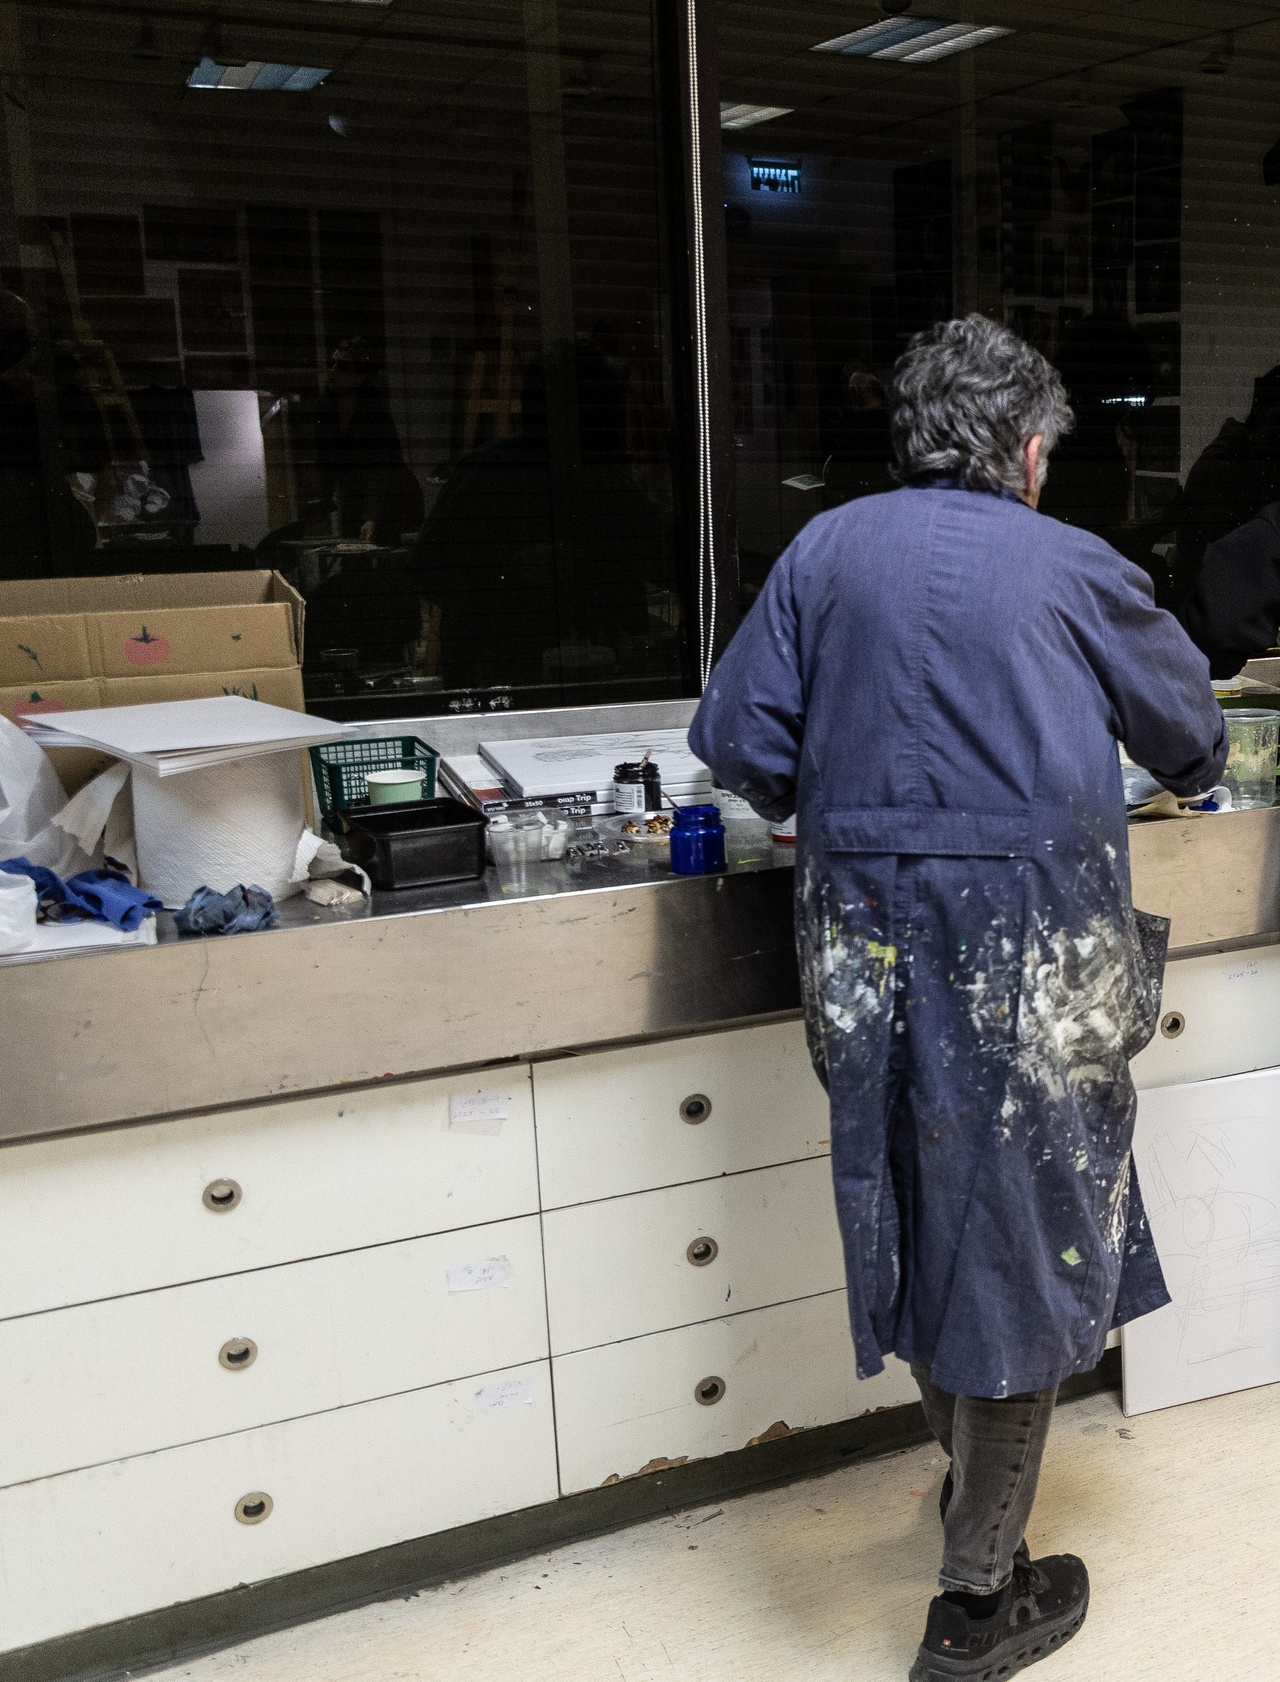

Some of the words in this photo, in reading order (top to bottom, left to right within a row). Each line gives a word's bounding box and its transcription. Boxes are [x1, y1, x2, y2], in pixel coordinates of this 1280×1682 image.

[575, 793, 592, 803] Trip
[524, 800, 544, 808] 35x50
[570, 806, 586, 815] Trip
